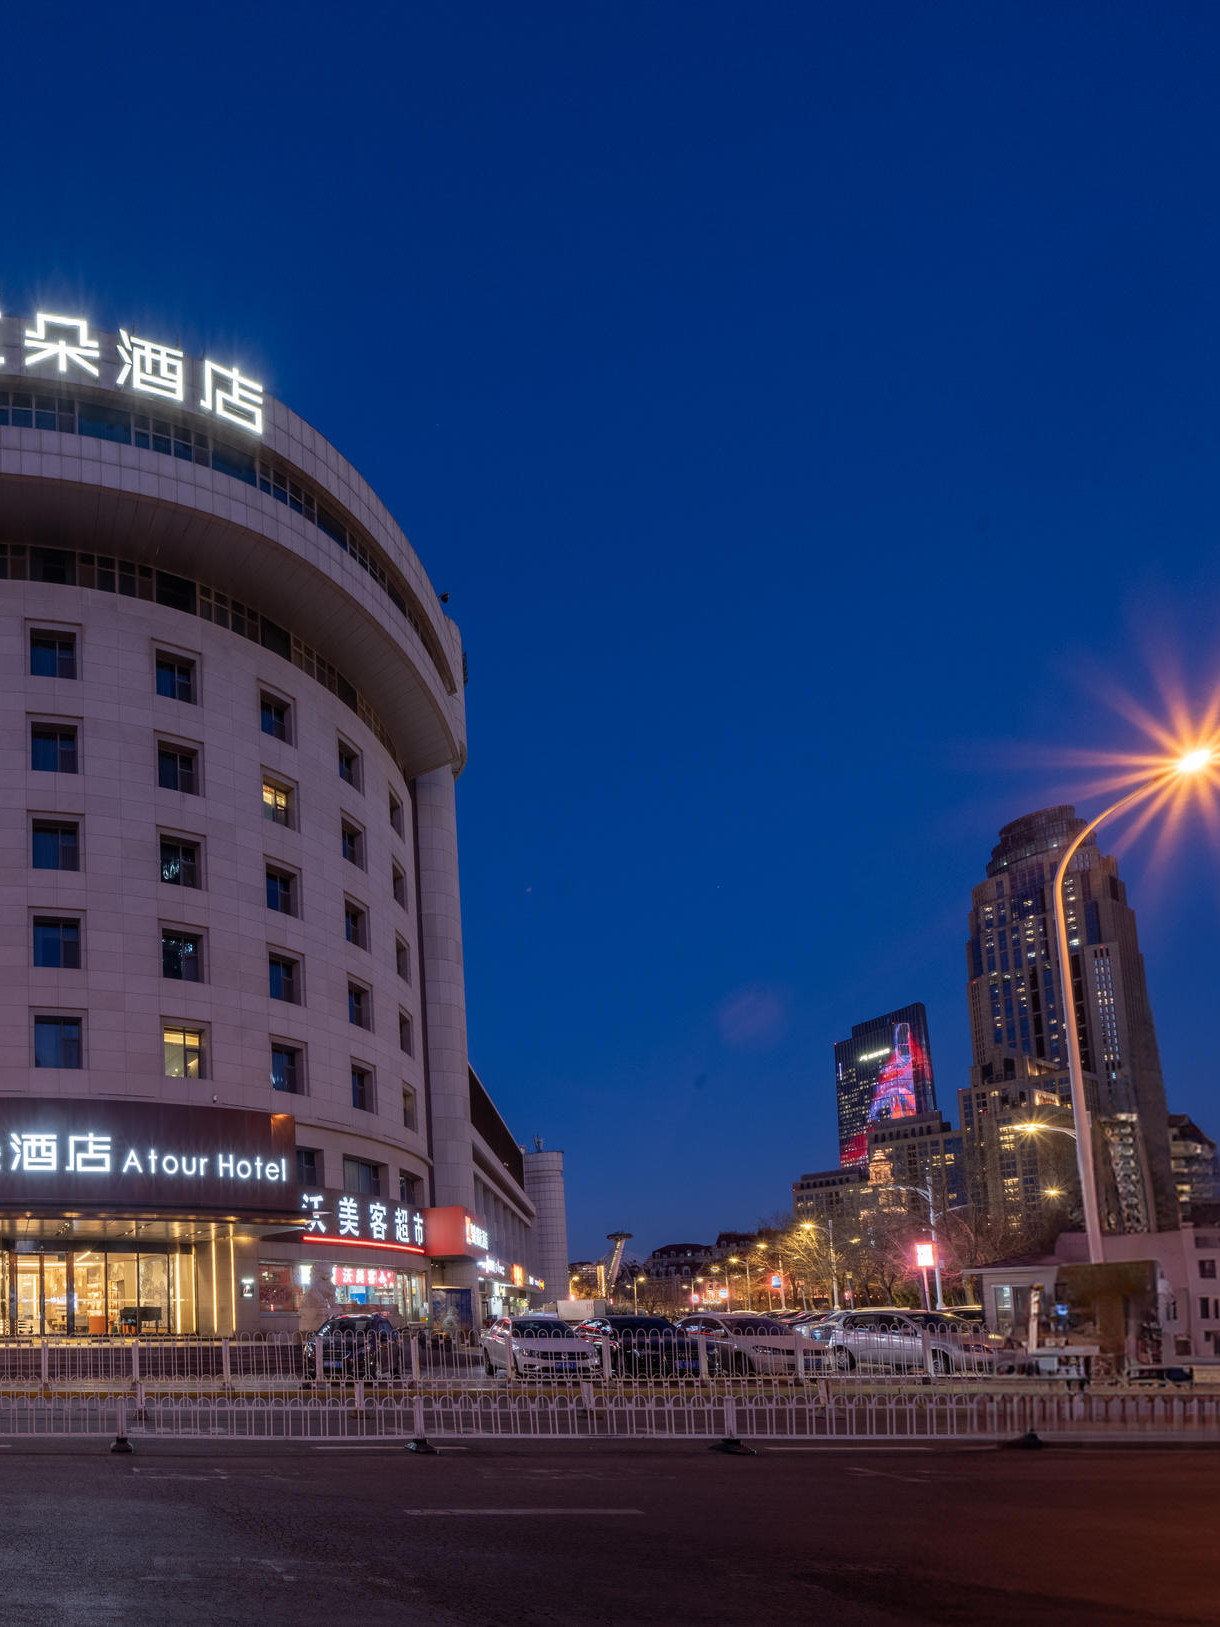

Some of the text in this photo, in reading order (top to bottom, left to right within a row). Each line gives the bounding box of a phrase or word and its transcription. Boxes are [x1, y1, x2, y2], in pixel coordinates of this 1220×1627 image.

[122, 1149, 287, 1182] Atour Hotel
[301, 1193, 424, 1247] 沃美客超市
